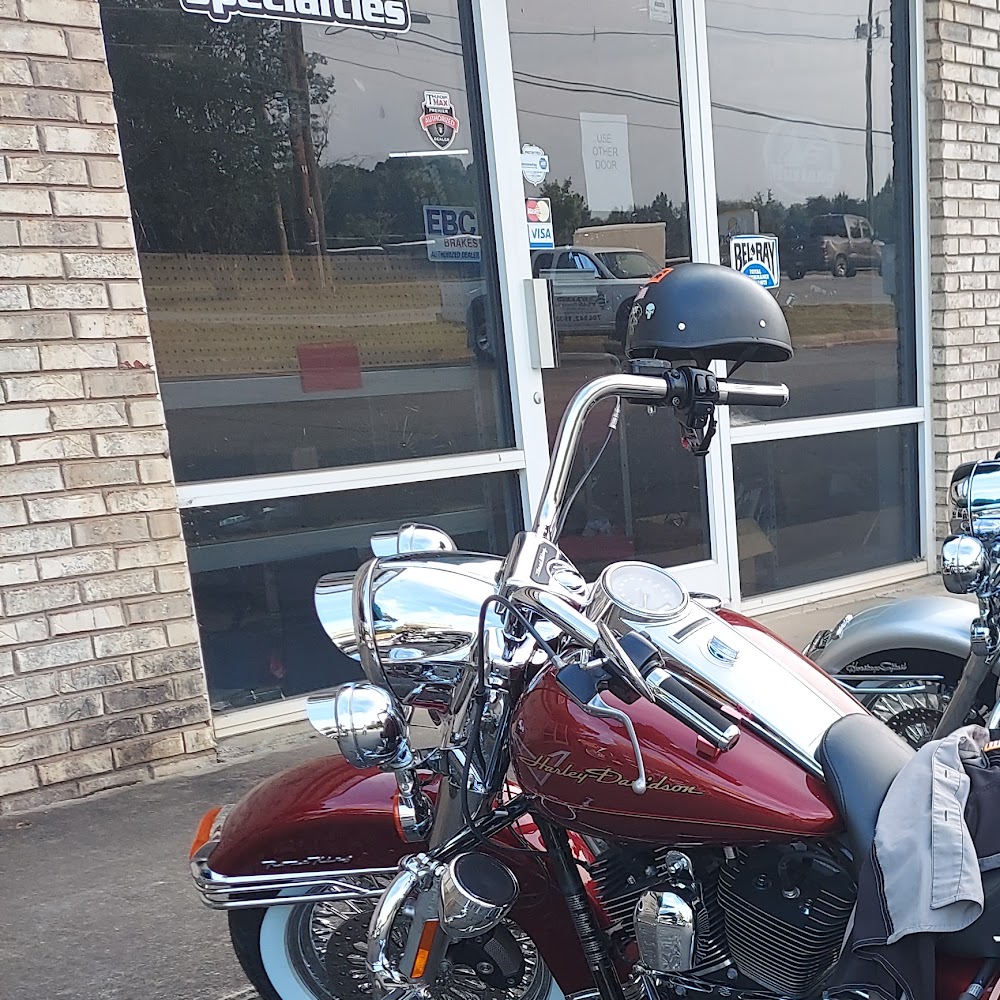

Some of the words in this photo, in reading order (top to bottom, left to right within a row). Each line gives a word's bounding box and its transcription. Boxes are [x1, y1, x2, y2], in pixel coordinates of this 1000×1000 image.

[186, 0, 405, 25] alties
[425, 114, 455, 126] AUTHORIZED
[596, 133, 611, 143] USE
[592, 146, 618, 157] OTHER
[595, 159, 617, 170] DOOR
[426, 209, 476, 236] EBC
[531, 228, 552, 239] VISA
[444, 238, 479, 248] BRAKES
[430, 251, 461, 259] AUTHORIZED
[461, 251, 481, 259] DEALER
[519, 755, 704, 796] Harley-Daidson
